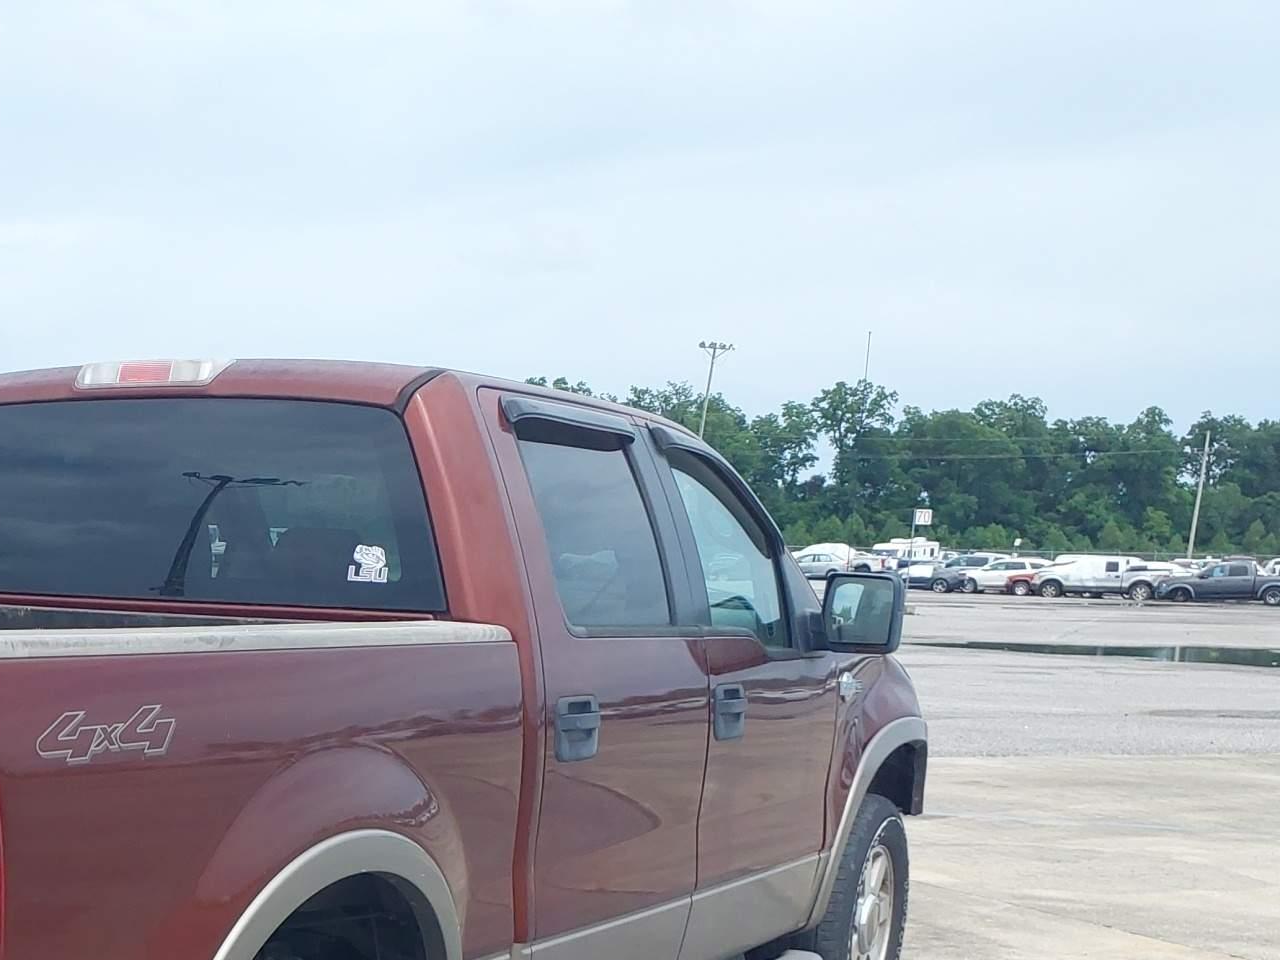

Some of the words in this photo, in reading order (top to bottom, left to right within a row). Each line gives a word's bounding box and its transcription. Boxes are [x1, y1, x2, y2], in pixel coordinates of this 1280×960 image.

[917, 510, 930, 523] 70
[347, 565, 388, 583] LSU
[36, 704, 176, 766] 4x4
